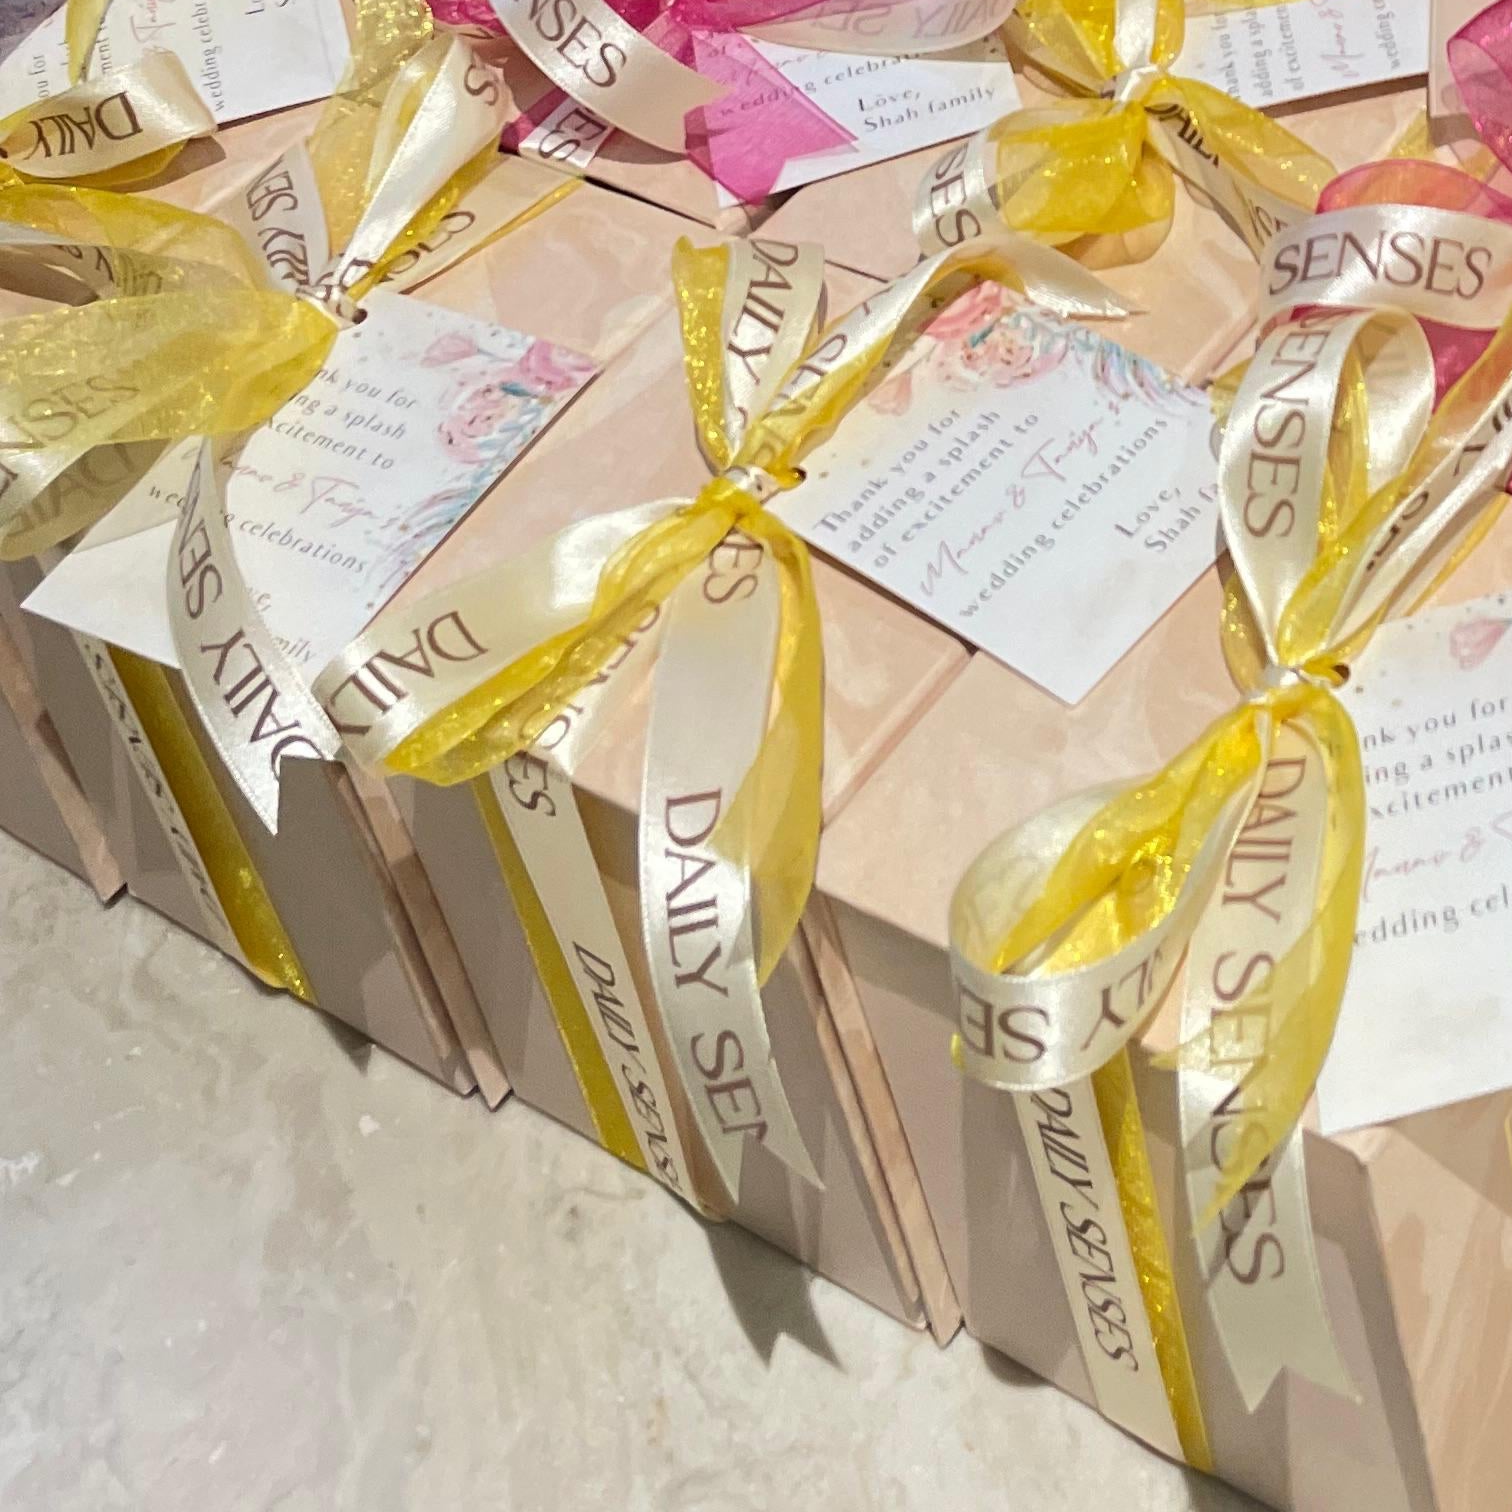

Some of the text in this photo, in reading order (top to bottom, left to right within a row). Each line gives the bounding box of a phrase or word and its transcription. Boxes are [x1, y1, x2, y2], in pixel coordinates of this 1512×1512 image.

[203, 36, 226, 116] wedding
[856, 87, 921, 113] Love,
[863, 83, 999, 133] Shah family
[27, 91, 143, 161] DAILY
[1269, 229, 1493, 299] SENSES
[728, 238, 799, 385] DAILY
[342, 375, 417, 409] you for
[342, 401, 405, 440] splash
[373, 452, 395, 471] to
[815, 407, 962, 535] Thank you for
[846, 408, 1001, 554] adding splash
[874, 412, 1040, 569] of excitement to
[239, 516, 368, 575] celebrations
[959, 416, 1169, 619] wedding celebrations
[1114, 486, 1182, 540] Love,
[1144, 504, 1203, 555] Shah
[323, 611, 490, 738] DAILY
[1408, 696, 1509, 741] you for
[1221, 755, 1307, 924] DAILY
[665, 790, 728, 997] DAILY
[1061, 1201, 1138, 1371] SENSES
